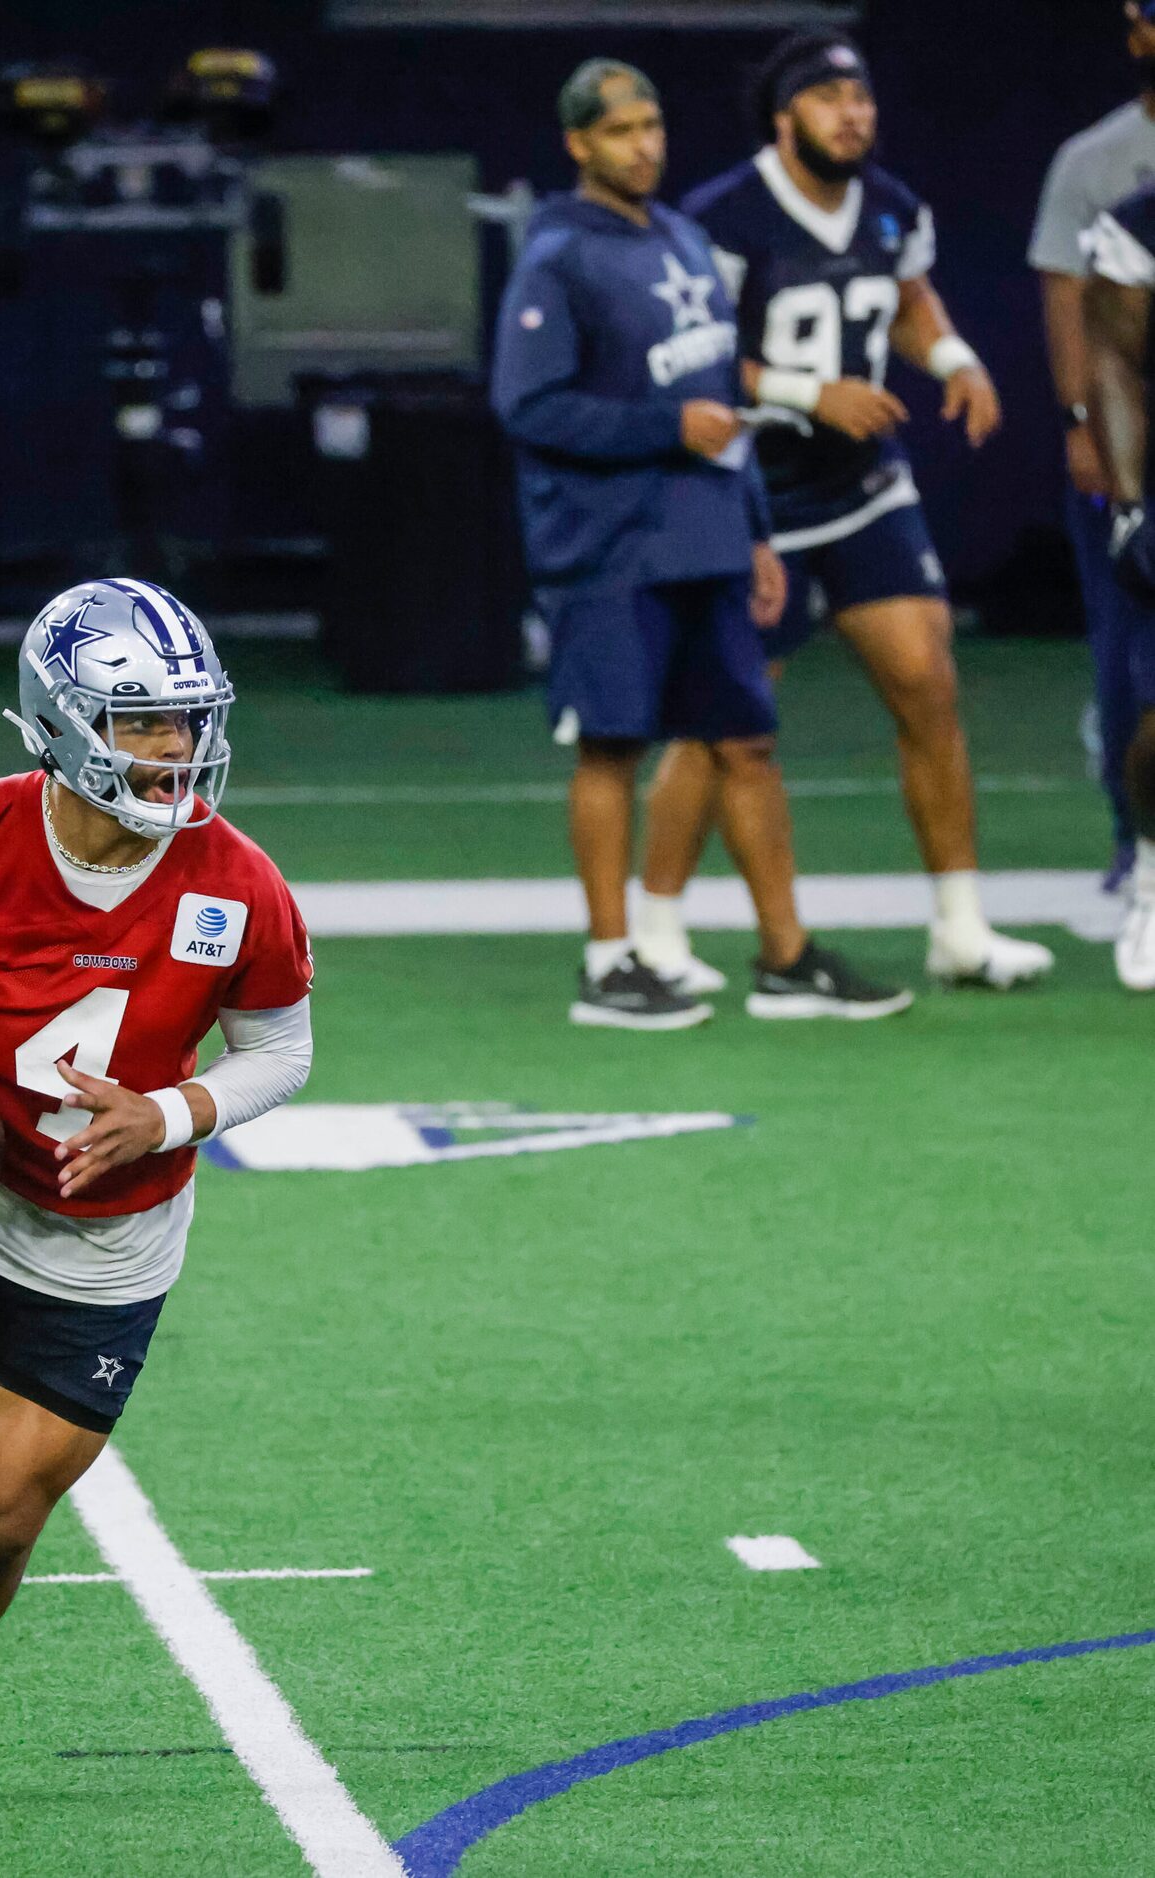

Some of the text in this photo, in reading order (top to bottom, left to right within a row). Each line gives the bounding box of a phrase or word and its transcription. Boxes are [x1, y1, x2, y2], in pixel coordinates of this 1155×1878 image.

[186, 940, 226, 957] AT&T
[73, 954, 138, 971] COWBOYS
[15, 987, 130, 1152] 4
